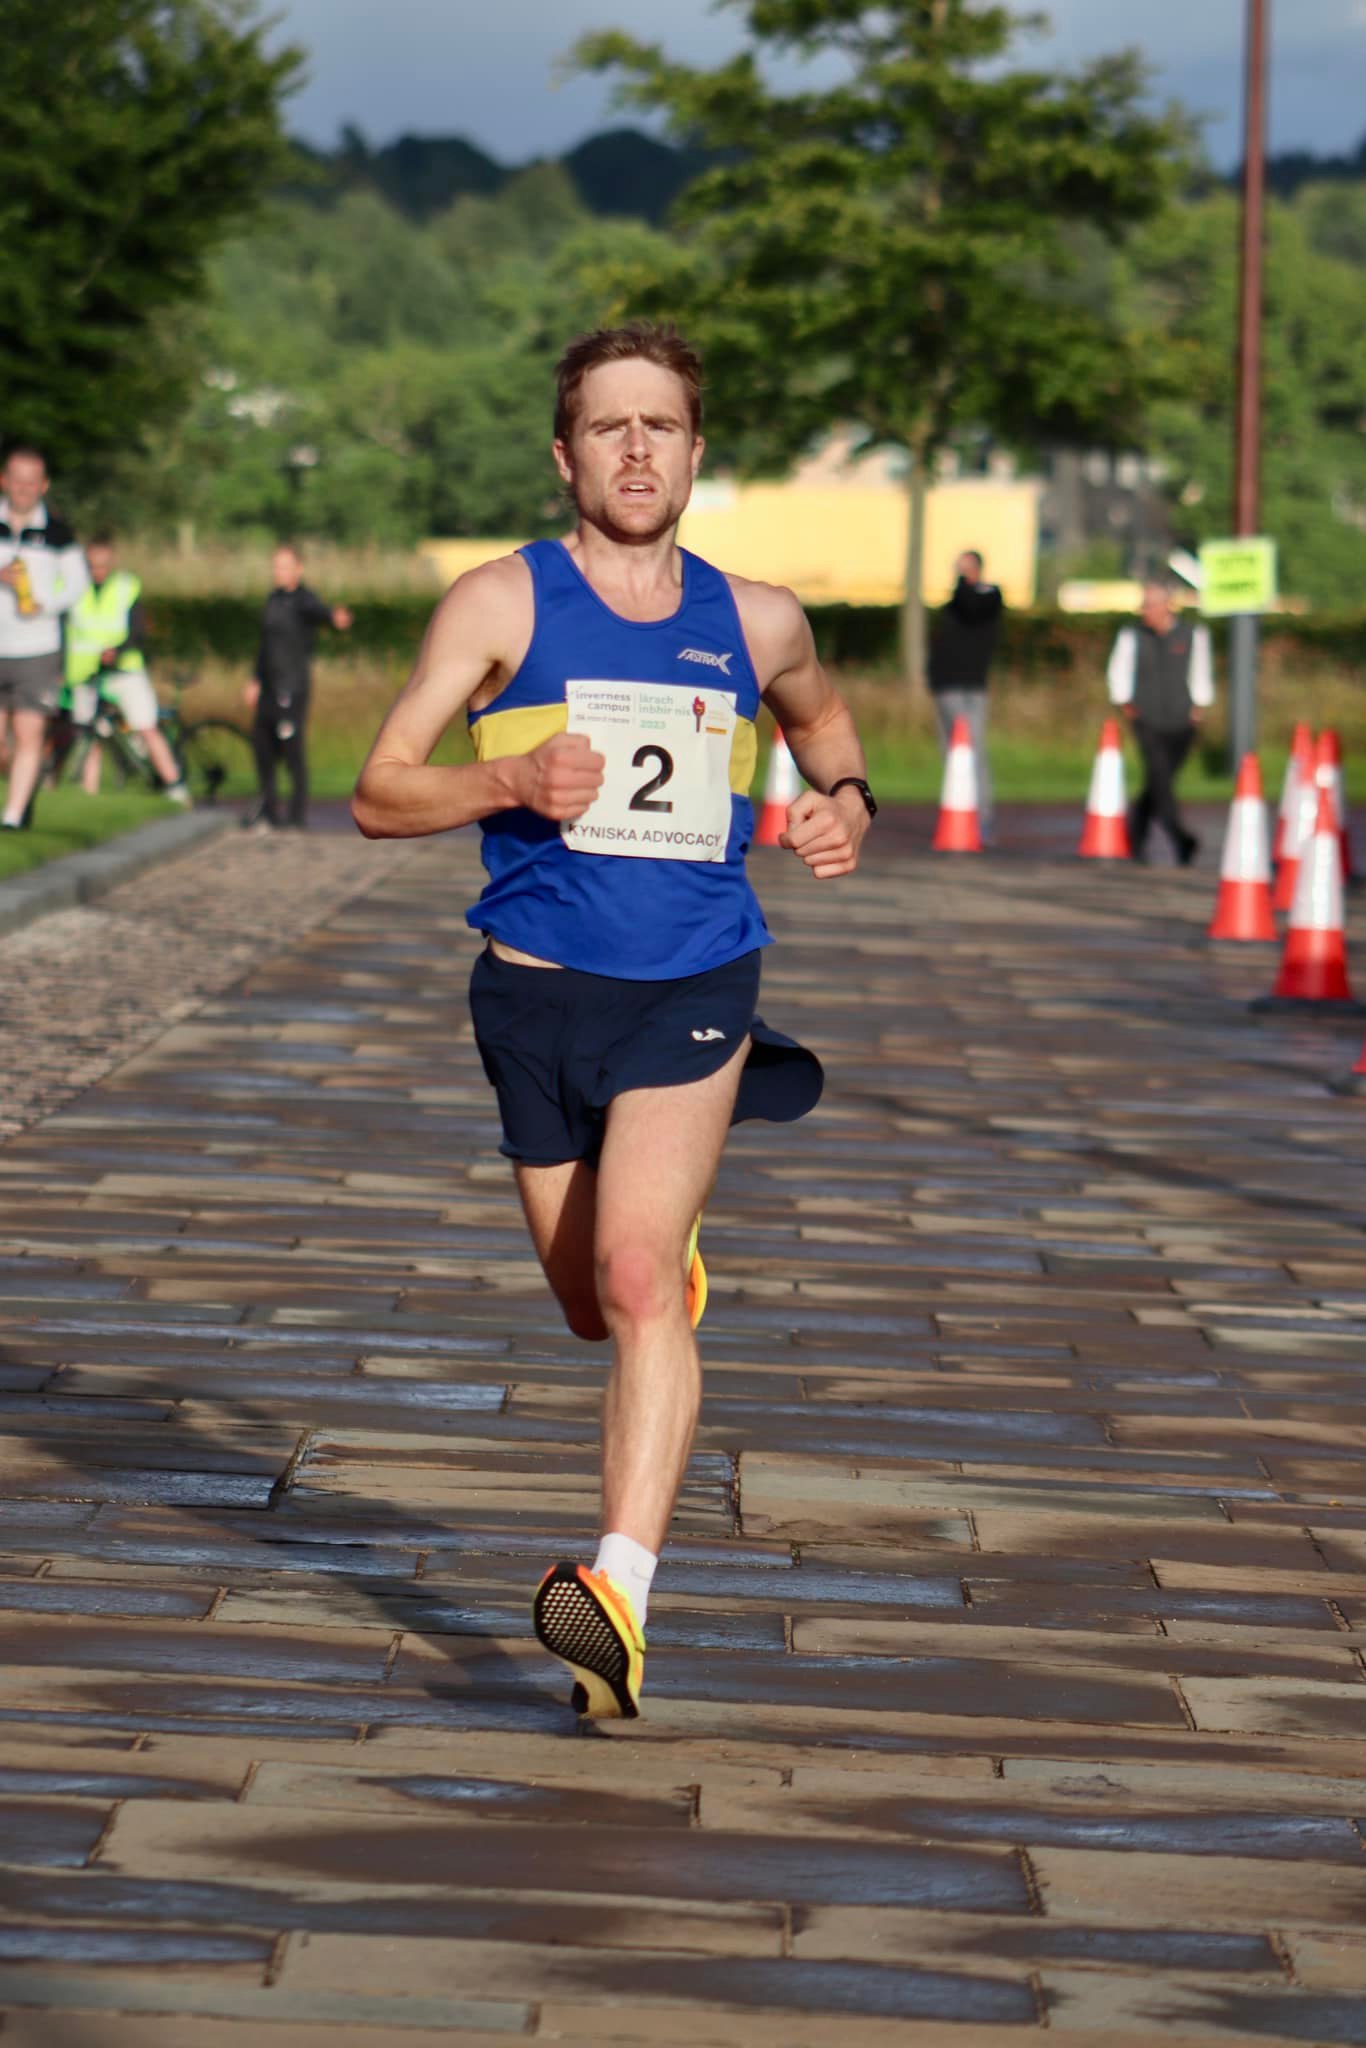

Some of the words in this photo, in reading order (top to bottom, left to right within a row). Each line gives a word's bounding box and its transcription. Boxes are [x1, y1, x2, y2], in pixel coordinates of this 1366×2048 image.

[575, 690, 631, 702] inverness
[587, 702, 631, 713] campus
[628, 744, 675, 813] 2
[568, 823, 638, 842] KYNISKA
[641, 829, 722, 848] ADVOCACY
